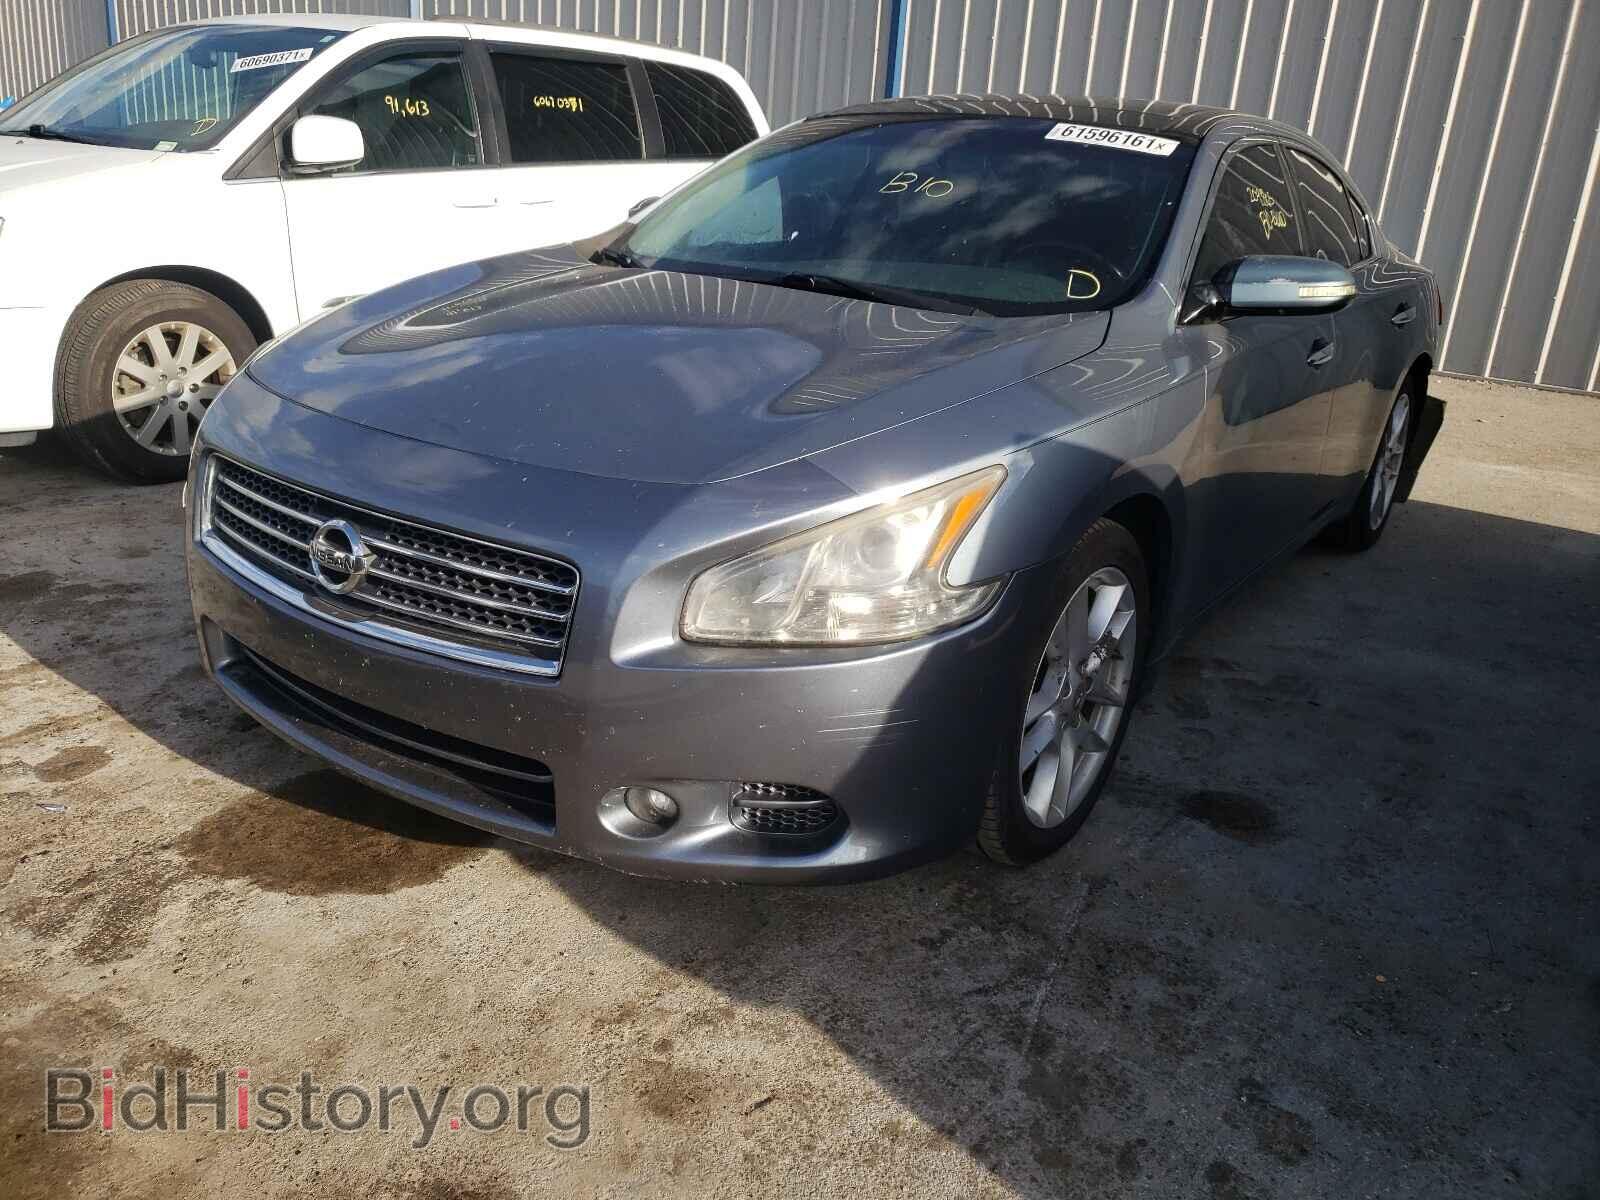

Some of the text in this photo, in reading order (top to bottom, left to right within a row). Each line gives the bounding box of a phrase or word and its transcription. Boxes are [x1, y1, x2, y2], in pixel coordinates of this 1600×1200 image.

[385, 95, 430, 118] 91,613
[1067, 269, 1101, 299] D
[310, 540, 354, 575] NISSAN
